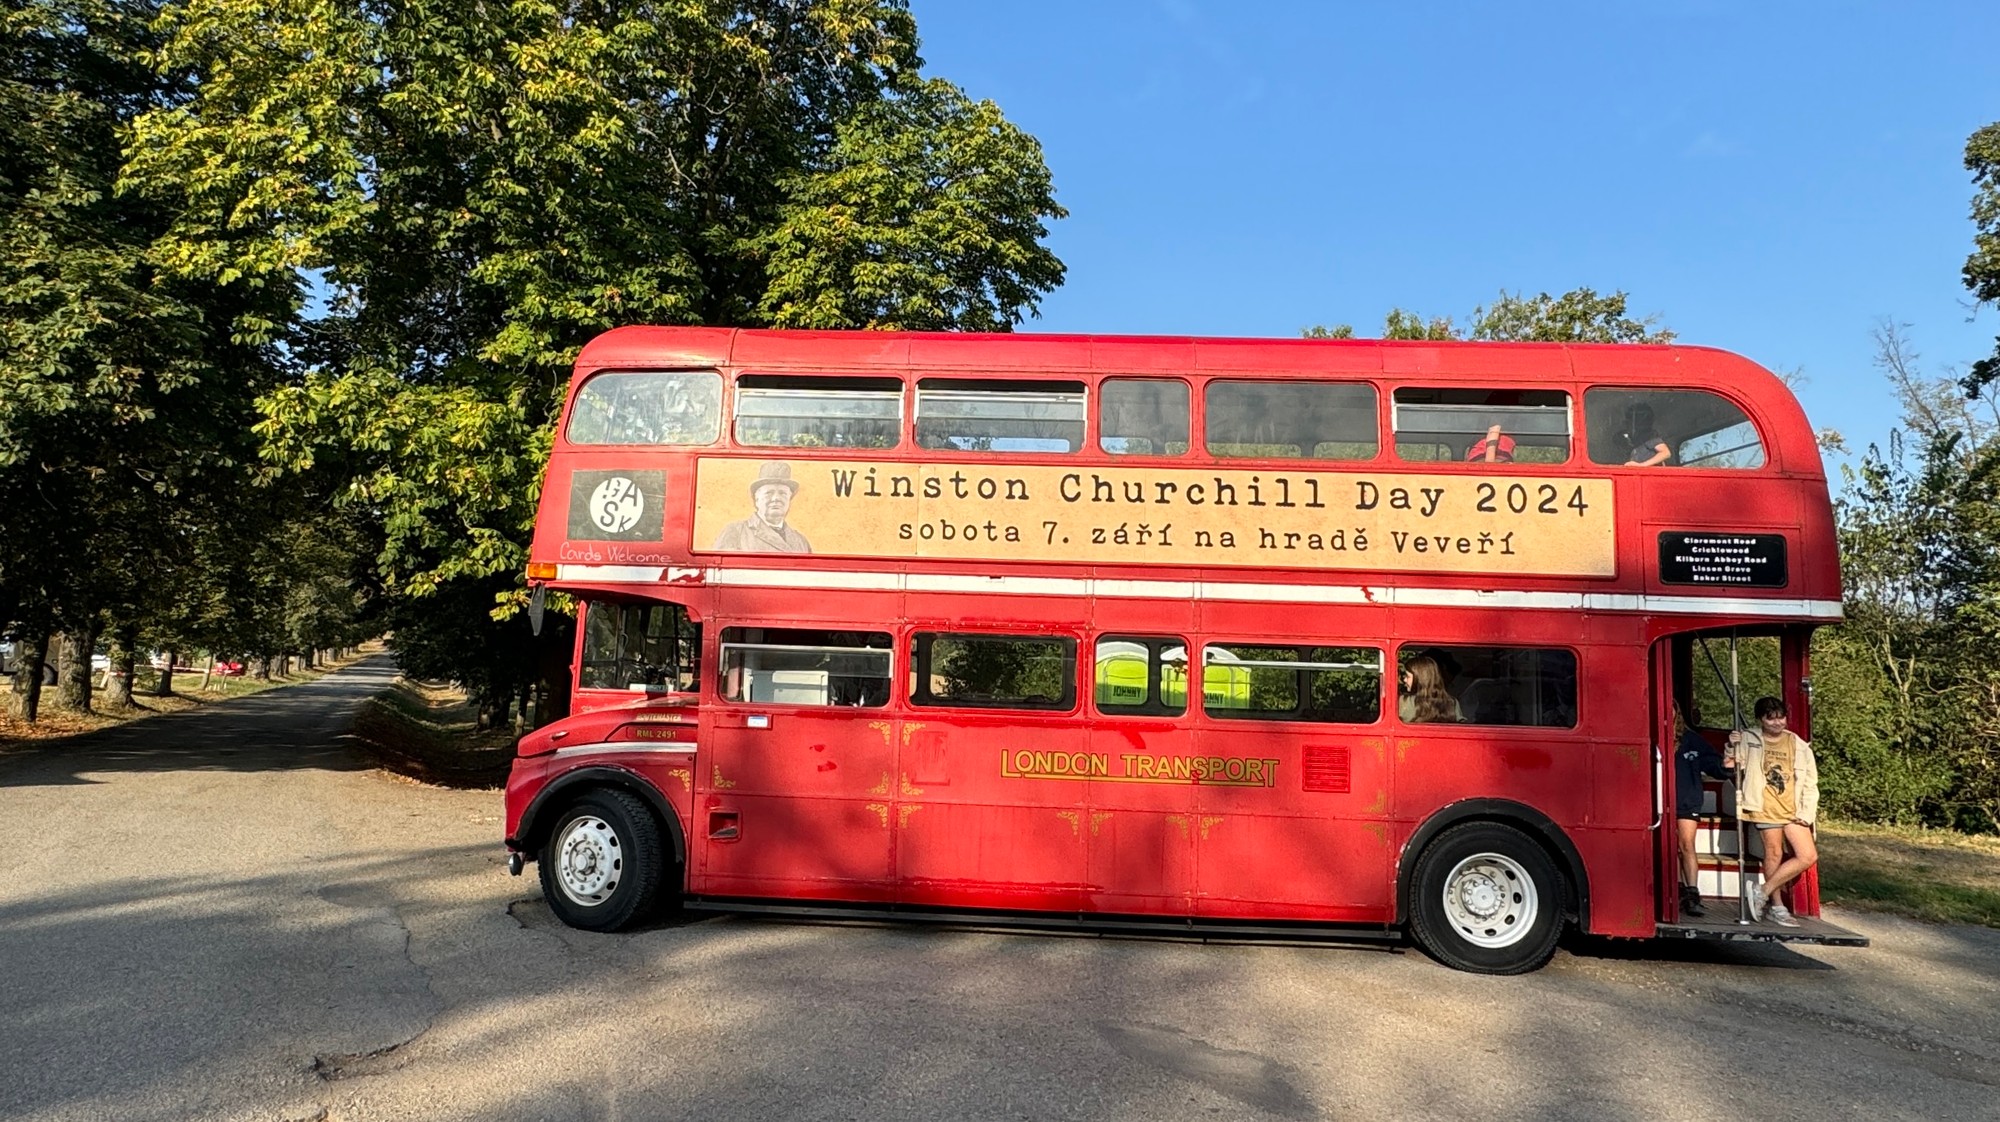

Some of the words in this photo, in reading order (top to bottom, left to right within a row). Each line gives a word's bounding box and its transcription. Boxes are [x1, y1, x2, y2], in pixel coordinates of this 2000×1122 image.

[833, 468, 1029, 500] Winston
[1060, 473, 1326, 508] Churchill
[1355, 479, 1444, 518] Day
[1476, 482, 1590, 517] 2024
[899, 519, 1021, 542] sobota
[1042, 520, 1069, 546] 7.
[1091, 522, 1174, 547] září
[1194, 530, 1236, 549] na
[1258, 527, 1369, 552] hradě
[1390, 530, 1516, 556] Veveří
[560, 541, 602, 561] Cards
[608, 545, 673, 562] Welcome
[1714, 556, 1743, 565] Abbey
[1693, 574, 1720, 582] Baker
[1112, 685, 1142, 698] JOHNNY
[636, 729, 655, 738] RML
[656, 730, 677, 739] 2491
[1000, 749, 1109, 778] LONDON
[1120, 753, 1281, 788] TRANSPORT
